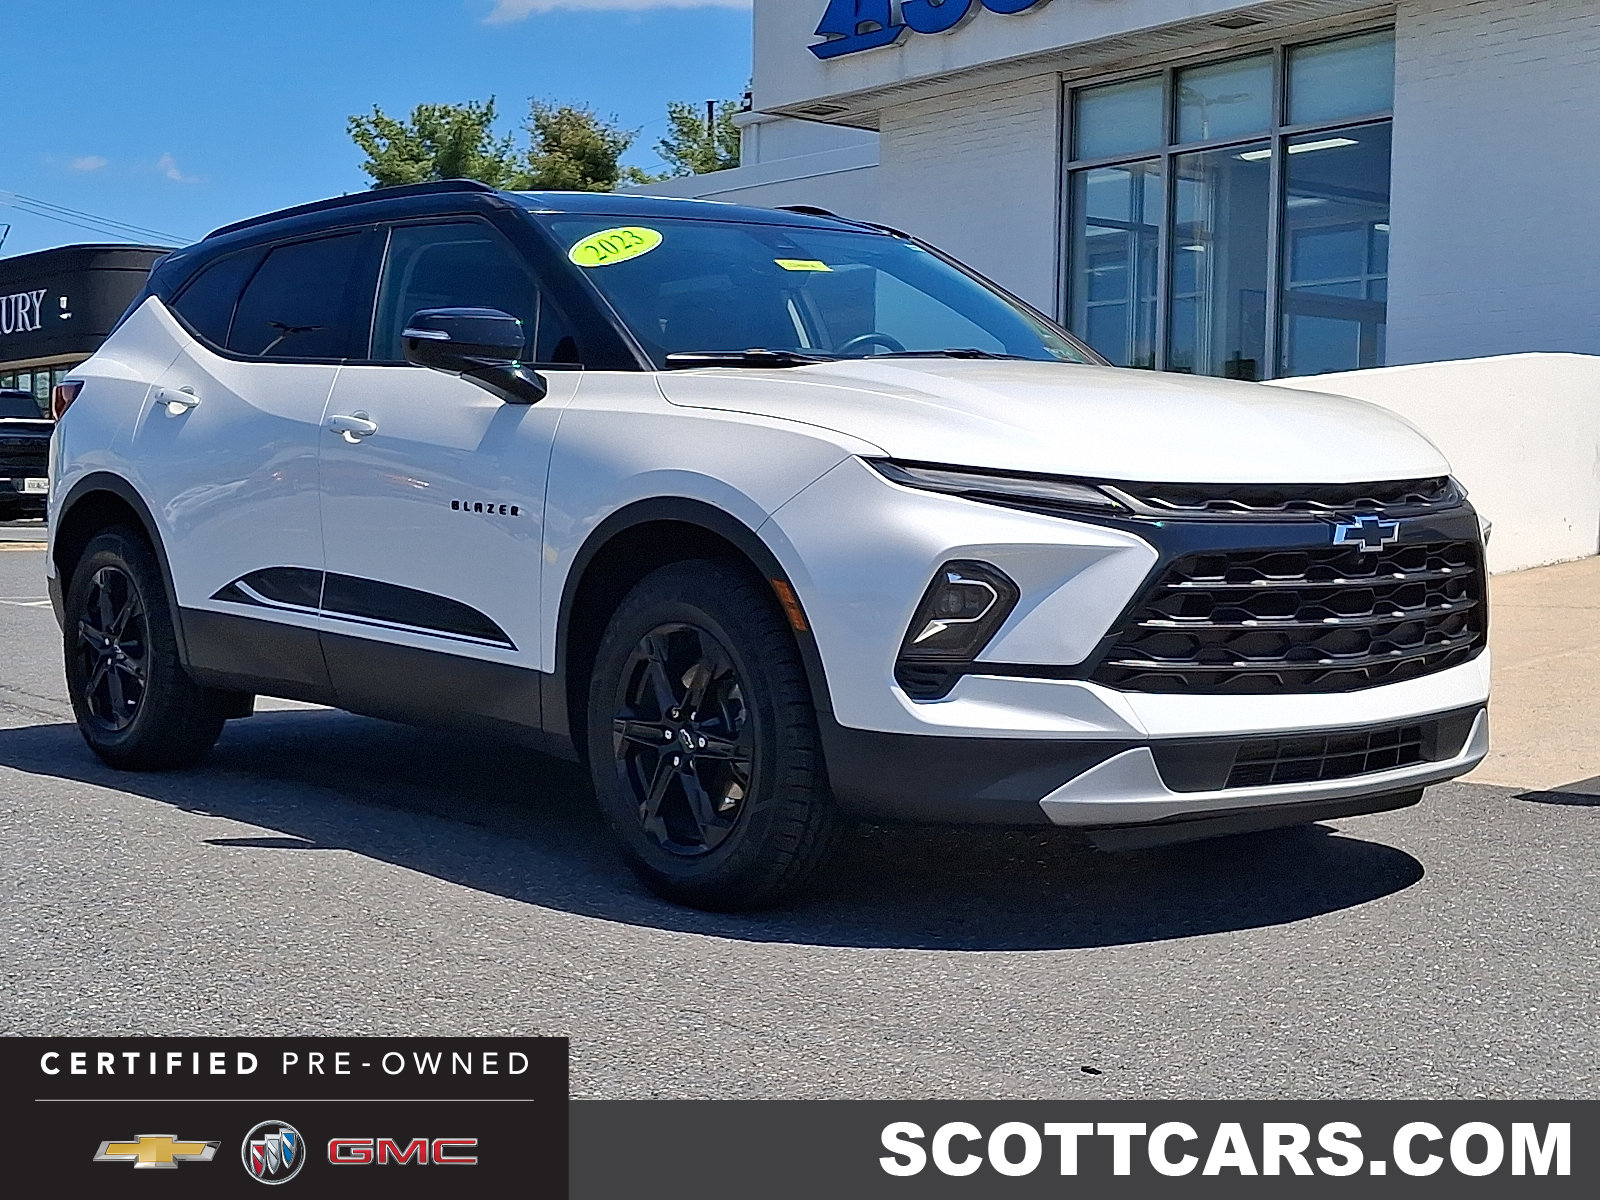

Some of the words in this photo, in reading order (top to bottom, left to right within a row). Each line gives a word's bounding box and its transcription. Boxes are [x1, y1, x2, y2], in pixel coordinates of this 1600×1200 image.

[585, 230, 644, 261] 2023
[0, 289, 47, 334] URY
[451, 500, 519, 517] BLAZER
